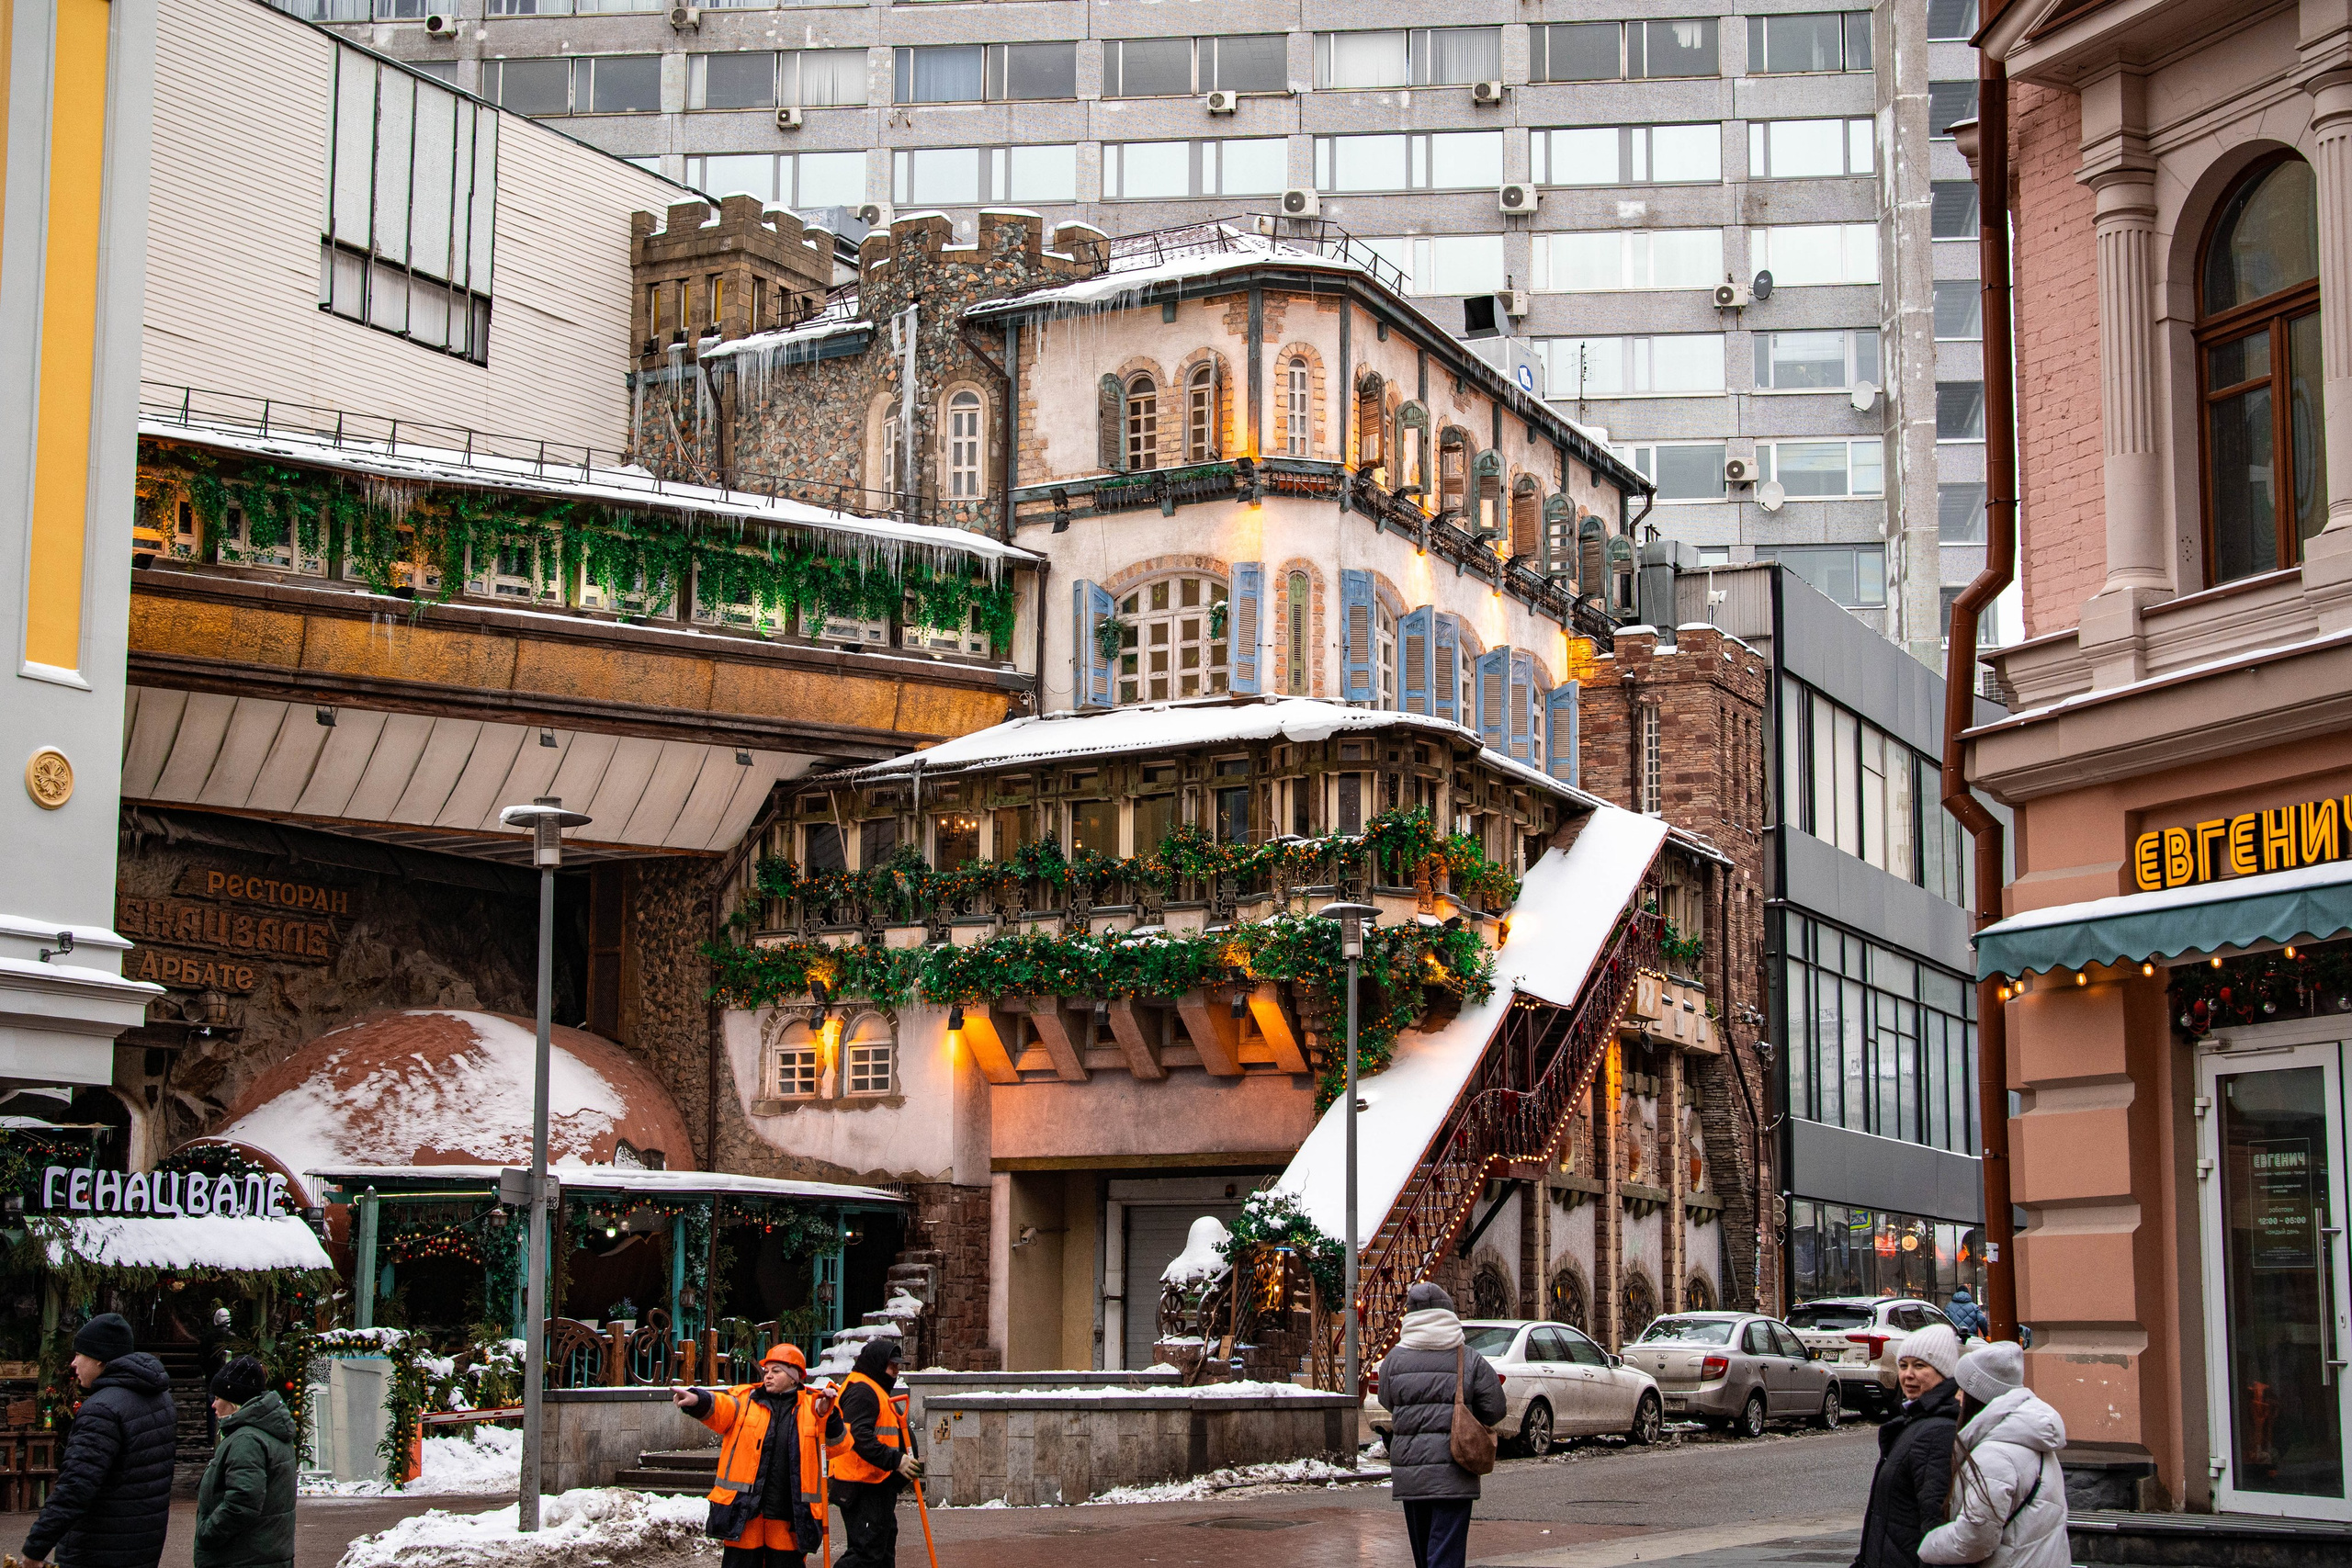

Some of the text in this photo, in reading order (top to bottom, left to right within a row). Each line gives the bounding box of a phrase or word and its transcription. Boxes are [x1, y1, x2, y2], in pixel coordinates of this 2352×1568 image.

[2134, 795, 2352, 891] ЕВГЕНИ
[206, 870, 348, 914] РЕСТОРАН
[117, 879, 329, 957] ЕНАЦВАЛЕ
[138, 950, 254, 990] АРБАТЕ
[2253, 1152, 2306, 1168] ЕВГЕНИЧ
[42, 1166, 288, 1219] ГЕНАЦВАЛЕ
